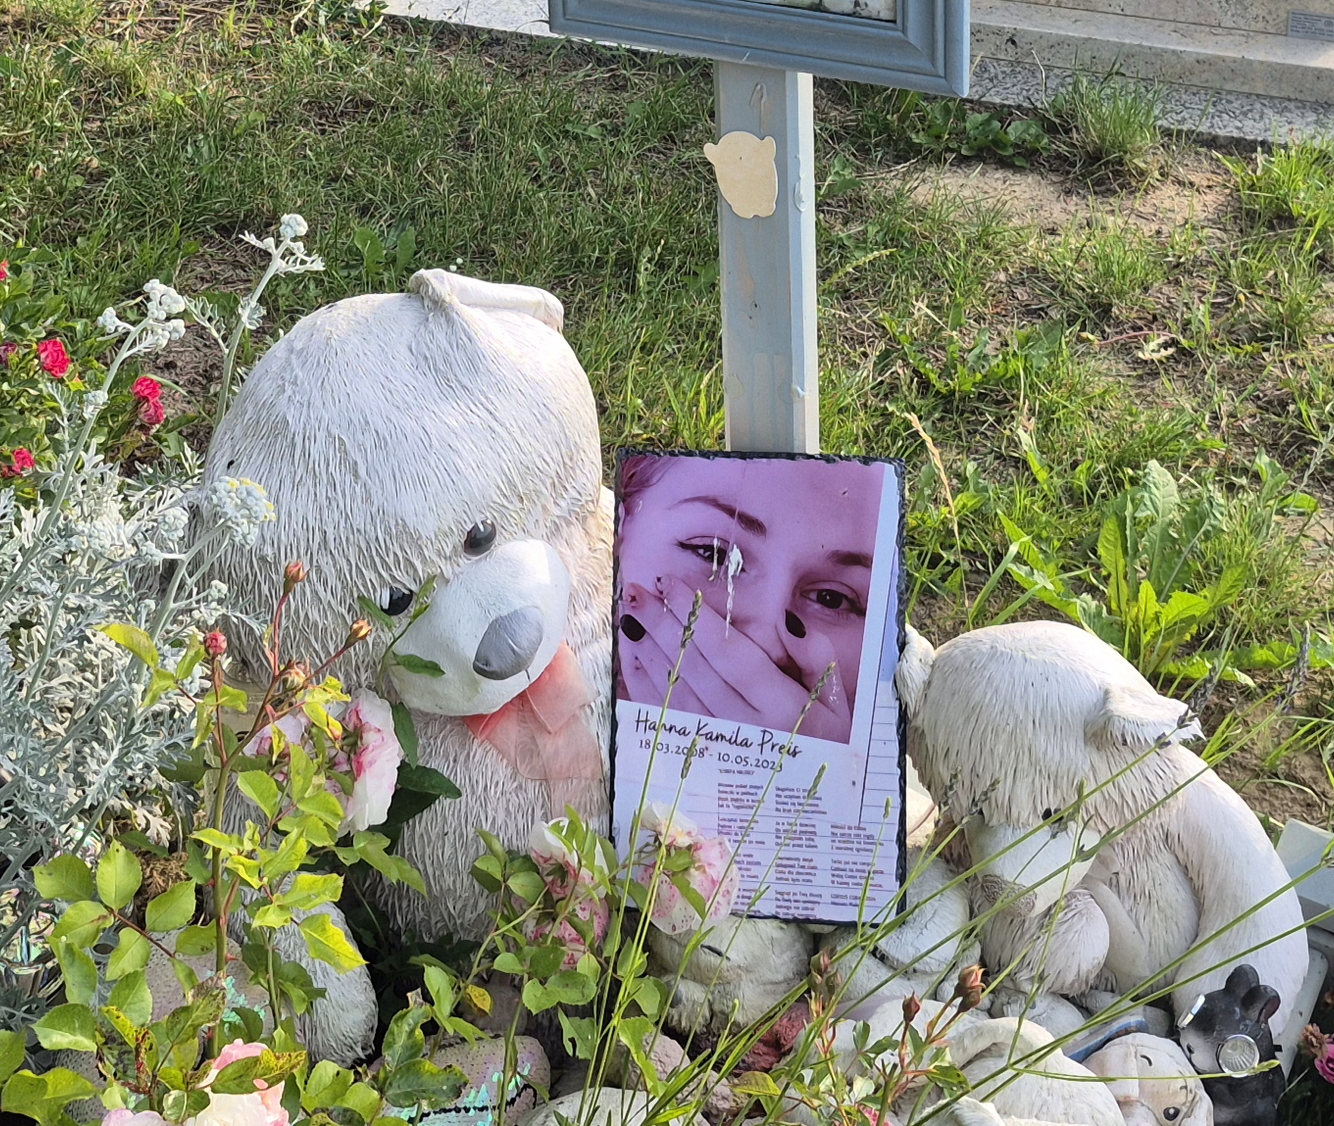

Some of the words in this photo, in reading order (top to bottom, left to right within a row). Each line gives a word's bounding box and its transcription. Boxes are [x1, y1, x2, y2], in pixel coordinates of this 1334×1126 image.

[635, 708, 691, 738] Hanna
[695, 718, 754, 749] Kamila
[757, 729, 803, 759] Preis
[639, 739, 705, 759] 1803.208
